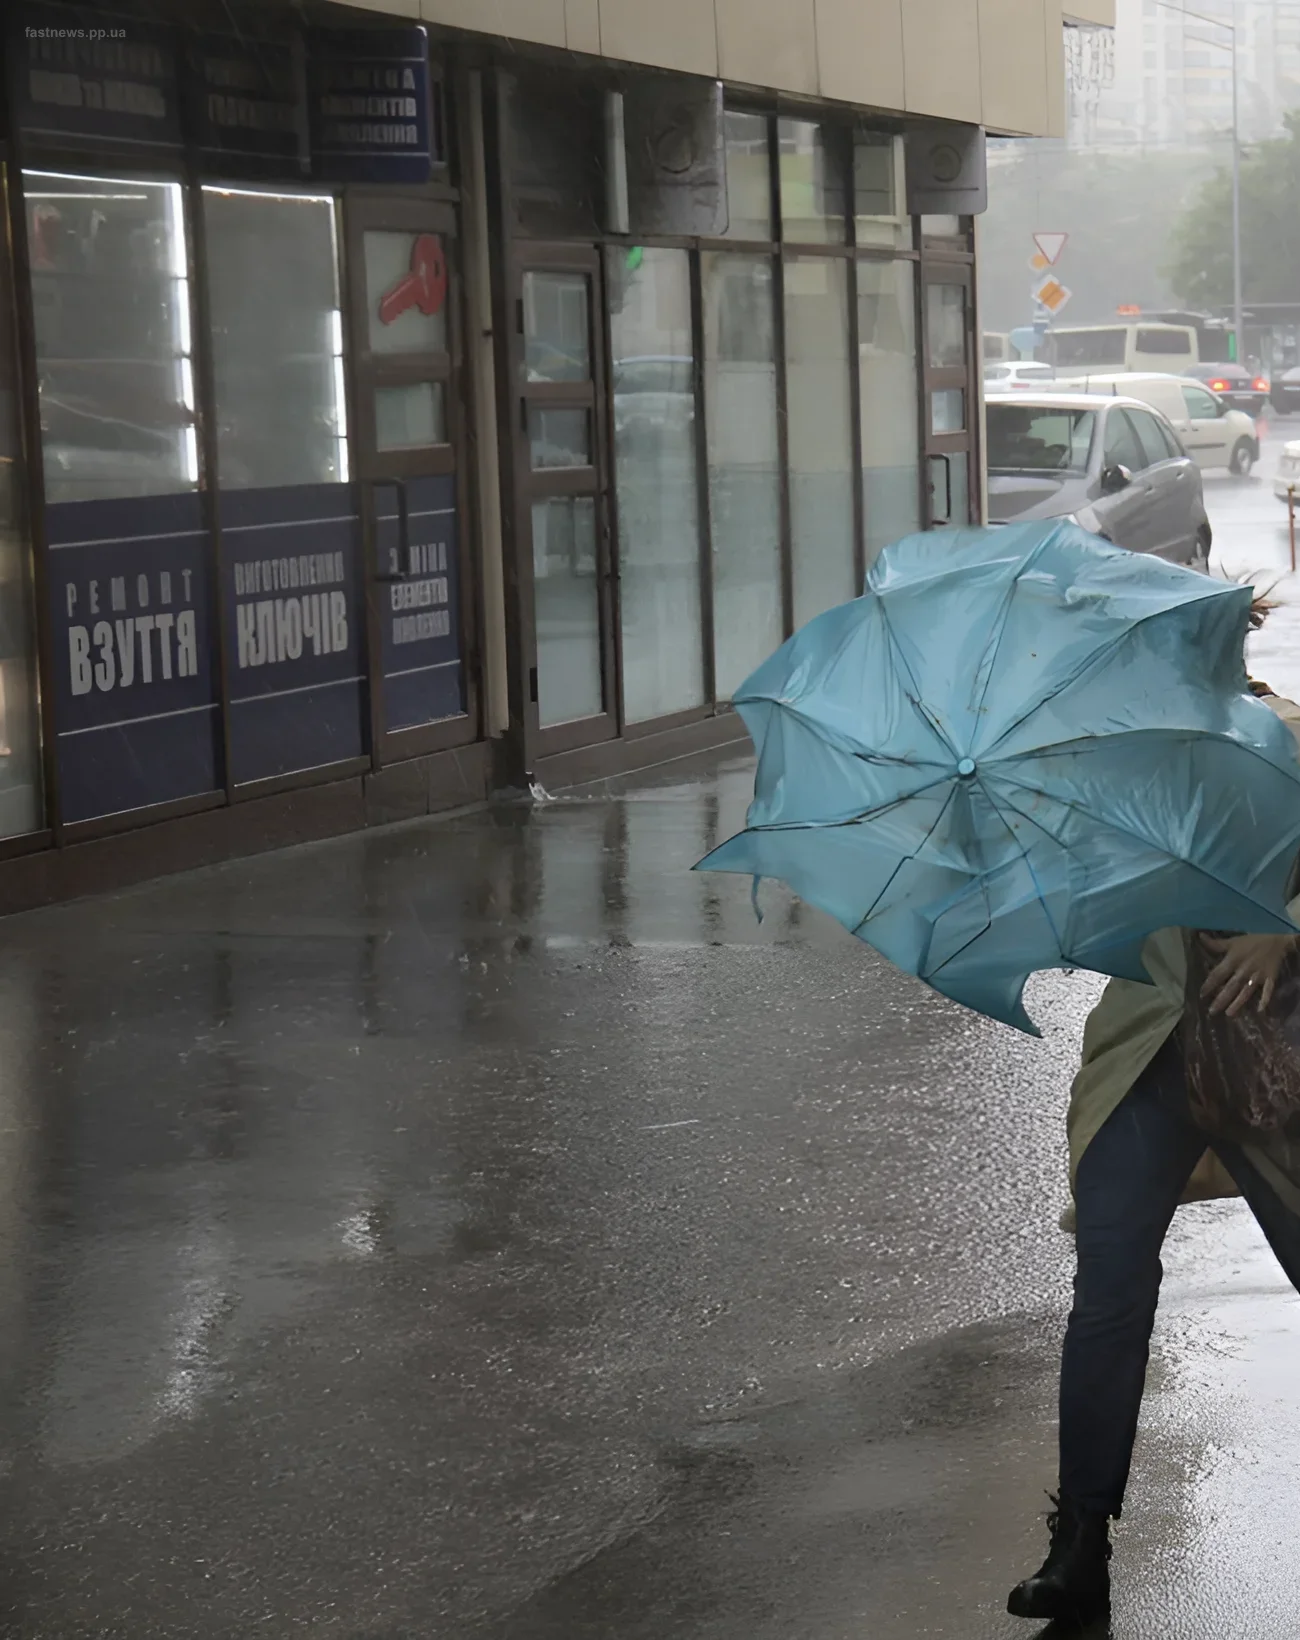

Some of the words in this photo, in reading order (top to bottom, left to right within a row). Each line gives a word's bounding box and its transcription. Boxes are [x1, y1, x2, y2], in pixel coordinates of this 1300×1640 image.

[65, 568, 193, 618] РЕМОНТ
[236, 590, 349, 669] КЛЮЧІВ
[68, 610, 198, 696] ВЗУТТЯ
